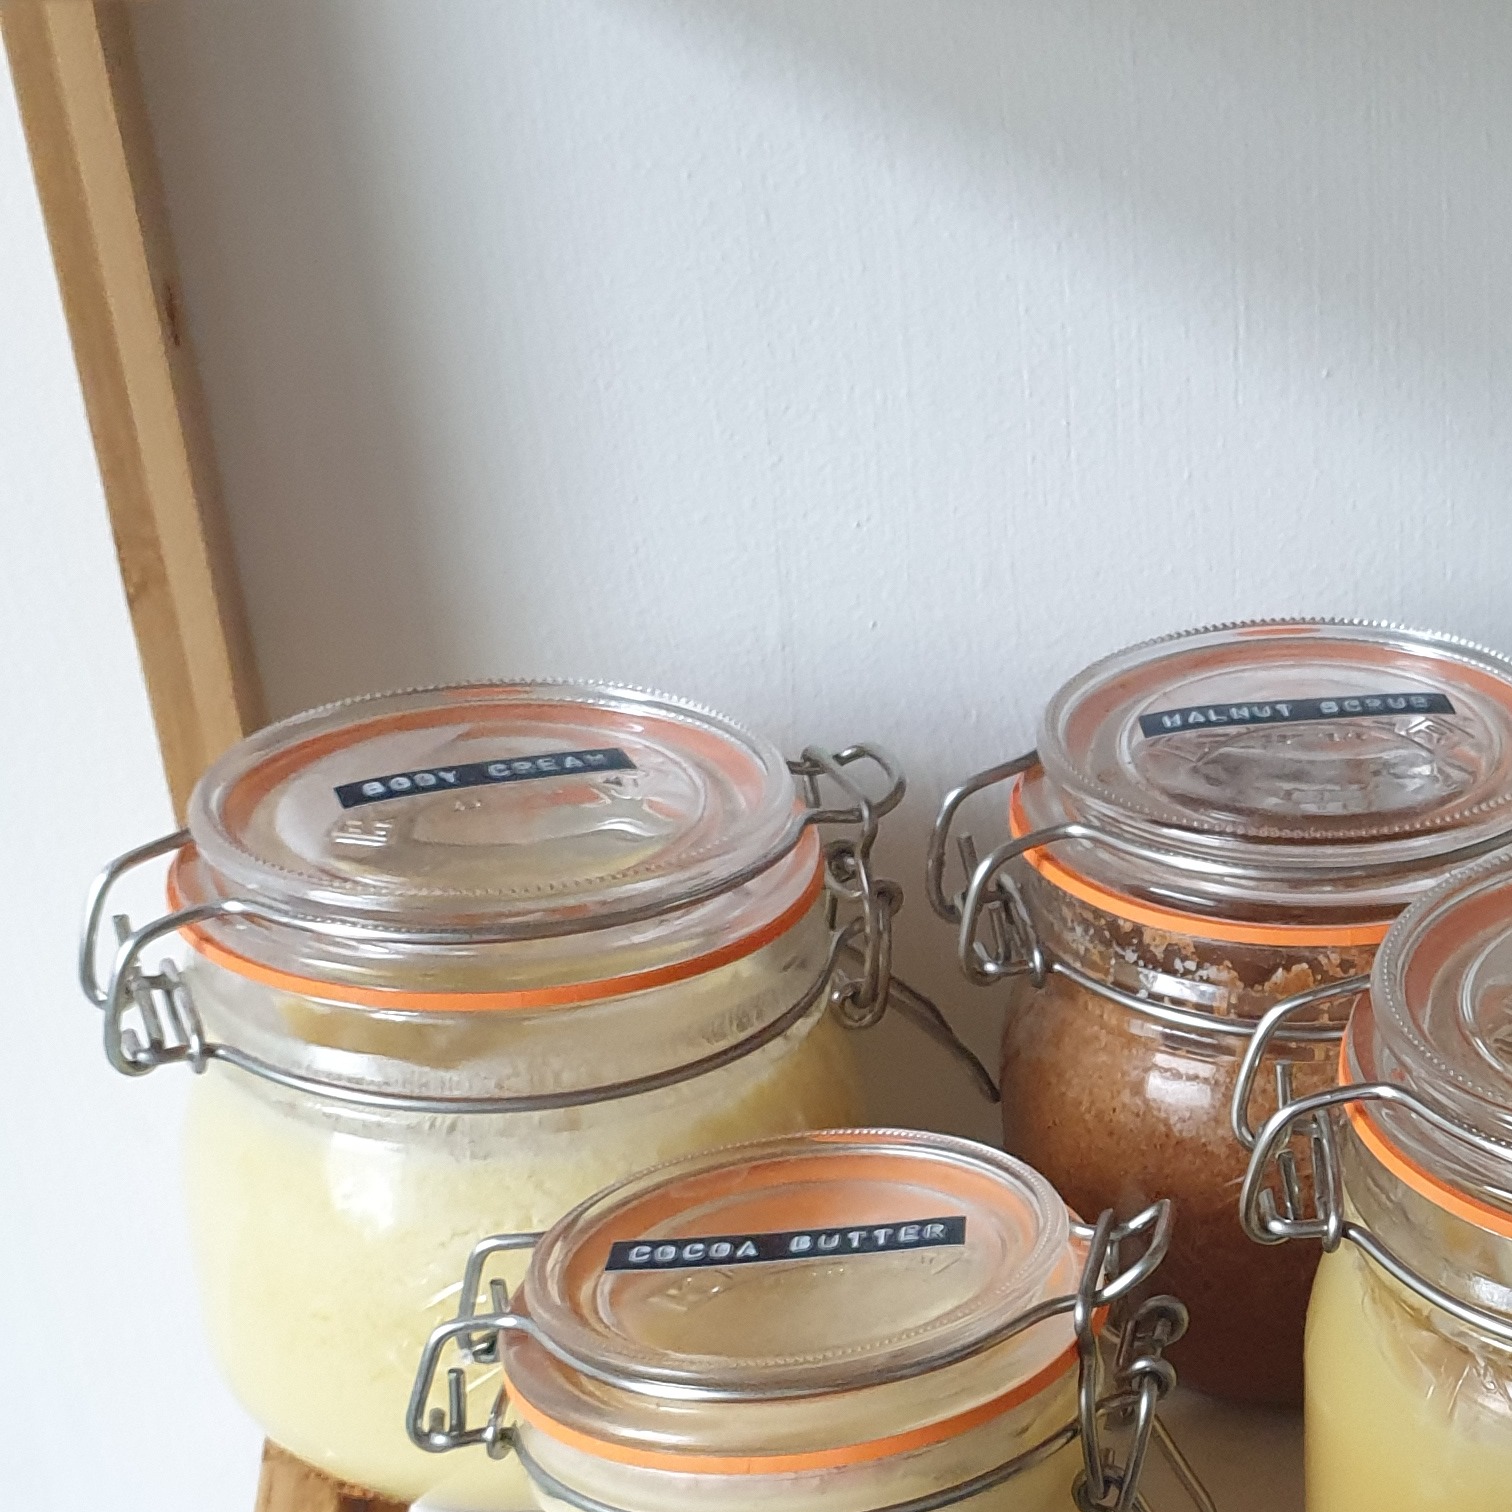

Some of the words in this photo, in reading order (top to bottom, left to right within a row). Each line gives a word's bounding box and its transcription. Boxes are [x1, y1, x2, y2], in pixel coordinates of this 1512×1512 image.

[1318, 695, 1431, 716] SCRUB
[361, 769, 459, 798] BODY
[486, 751, 606, 778] CREAM
[627, 1240, 760, 1263] COCOA
[788, 1223, 946, 1254] BUTTER
